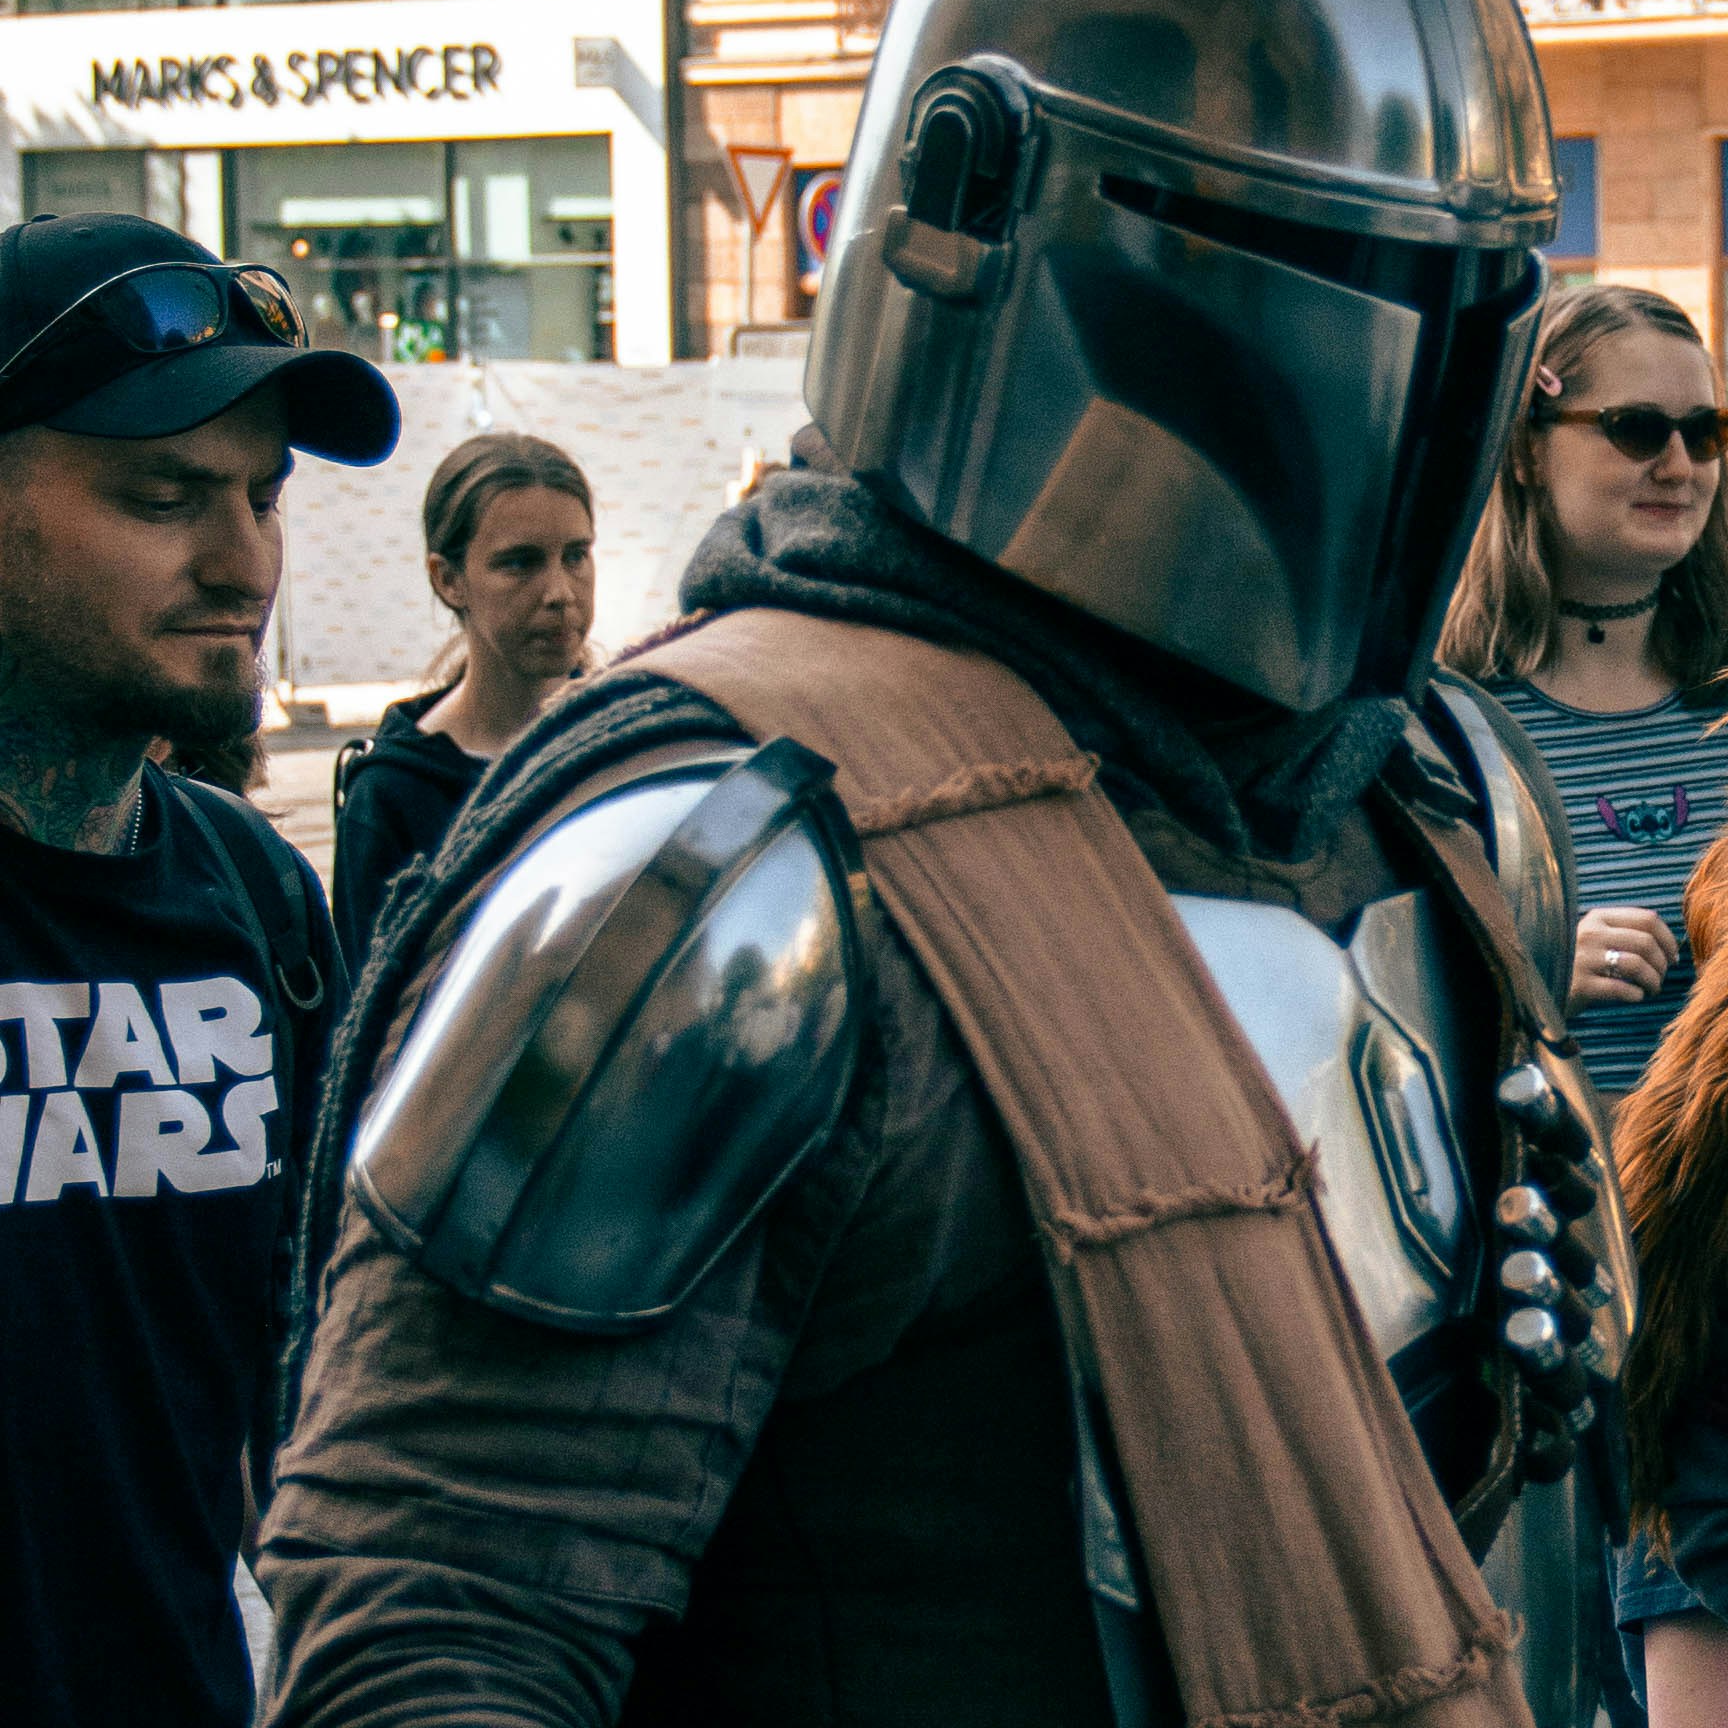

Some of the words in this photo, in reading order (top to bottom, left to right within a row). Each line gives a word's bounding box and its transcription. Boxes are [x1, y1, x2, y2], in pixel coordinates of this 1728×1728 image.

[91, 52, 241, 107] MARKS
[250, 52, 278, 105] &
[287, 43, 501, 103] SPENCER
